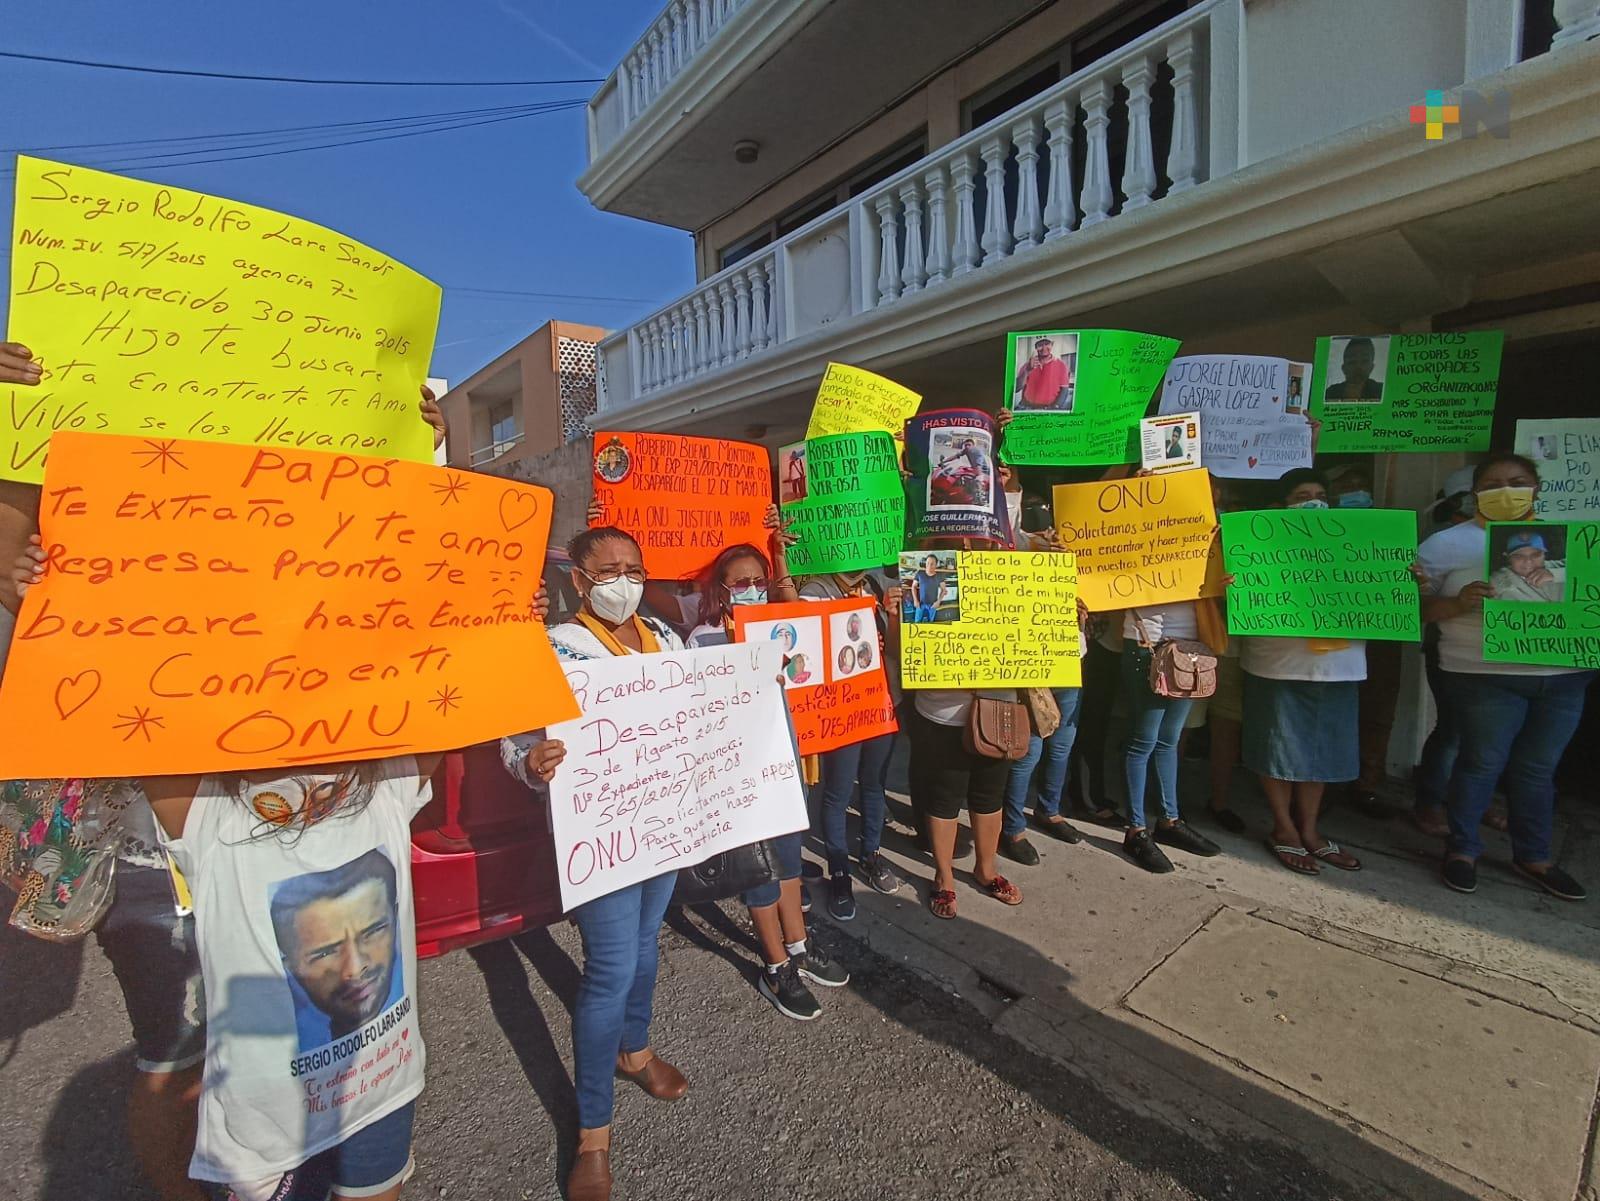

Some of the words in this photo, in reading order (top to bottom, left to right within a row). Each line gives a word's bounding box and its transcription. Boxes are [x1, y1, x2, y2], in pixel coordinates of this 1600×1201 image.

[31, 168, 139, 220] Sergio
[261, 221, 326, 253] Lara
[233, 258, 314, 289] agencia
[16, 261, 229, 313] Desaparecido
[252, 300, 294, 323] 30
[304, 315, 362, 341] Junio
[375, 328, 411, 355] 2015
[1399, 332, 1466, 348] PEDIMOS
[271, 337, 384, 382] buscare
[1413, 349, 1450, 361] TODAS
[1457, 349, 1479, 359] LAS
[1174, 361, 1226, 386] JORGE
[1178, 385, 1222, 409] GASPAR
[140, 416, 167, 430] se
[188, 411, 231, 435] los
[950, 417, 983, 428] VISTO
[1325, 420, 1373, 433] JAVIER
[634, 433, 676, 458] ROBERTO
[807, 439, 858, 461] ROBERTO
[1098, 478, 1167, 513] ONU
[1559, 497, 1577, 512] SE
[646, 506, 669, 528] ONU
[676, 508, 723, 528] JUSTICIA
[729, 511, 750, 527] PARA
[922, 514, 939, 523] JOSE
[940, 512, 985, 523] GUILLERMO
[1250, 514, 1347, 542] ONU
[701, 530, 725, 547] CASA
[1062, 520, 1137, 544] Solicitamos
[1141, 521, 1154, 532] su
[440, 532, 523, 562] amo
[819, 541, 862, 563] HASTA
[866, 540, 879, 559] EL
[961, 550, 992, 566] Pido
[1010, 554, 1021, 566] la
[1343, 542, 1369, 563] SU
[958, 565, 1006, 581] Justicia
[1010, 573, 1029, 585] por
[1033, 571, 1044, 583] la
[1281, 568, 1329, 585] PARA
[1016, 584, 1033, 598] de
[1232, 592, 1240, 612] Y
[1249, 591, 1300, 611] HACER
[1305, 586, 1386, 608] JUSTICIA
[1392, 587, 1417, 606] PARA
[18, 600, 263, 640] buscare
[303, 601, 413, 631] hasta
[1232, 612, 1306, 631] NUESTROS
[1311, 610, 1418, 633] DESAPARECIDOS
[1005, 628, 1021, 642] el
[1485, 633, 1510, 655] SU
[904, 641, 926, 655] del
[933, 642, 965, 656] 2018
[970, 645, 988, 655] en
[991, 642, 1005, 656] el
[973, 656, 991, 667] de
[660, 655, 735, 698] Delgado
[814, 684, 838, 700] ONU
[842, 682, 860, 704] Para
[216, 700, 411, 755] ONU
[573, 768, 599, 788] 3
[603, 757, 623, 777] de
[635, 734, 689, 767] Agosto
[695, 715, 729, 741] 2015
[644, 784, 736, 832] Solicitamos
[640, 830, 679, 852] Para
[683, 817, 706, 838] que
[705, 809, 721, 820] se
[727, 791, 759, 809] haga
[655, 819, 733, 867] Justicia
[567, 826, 637, 886] ONU
[290, 1048, 331, 1077] SERGIO
[332, 1025, 377, 1063] RODOLFO
[376, 1011, 397, 1038] LARA
